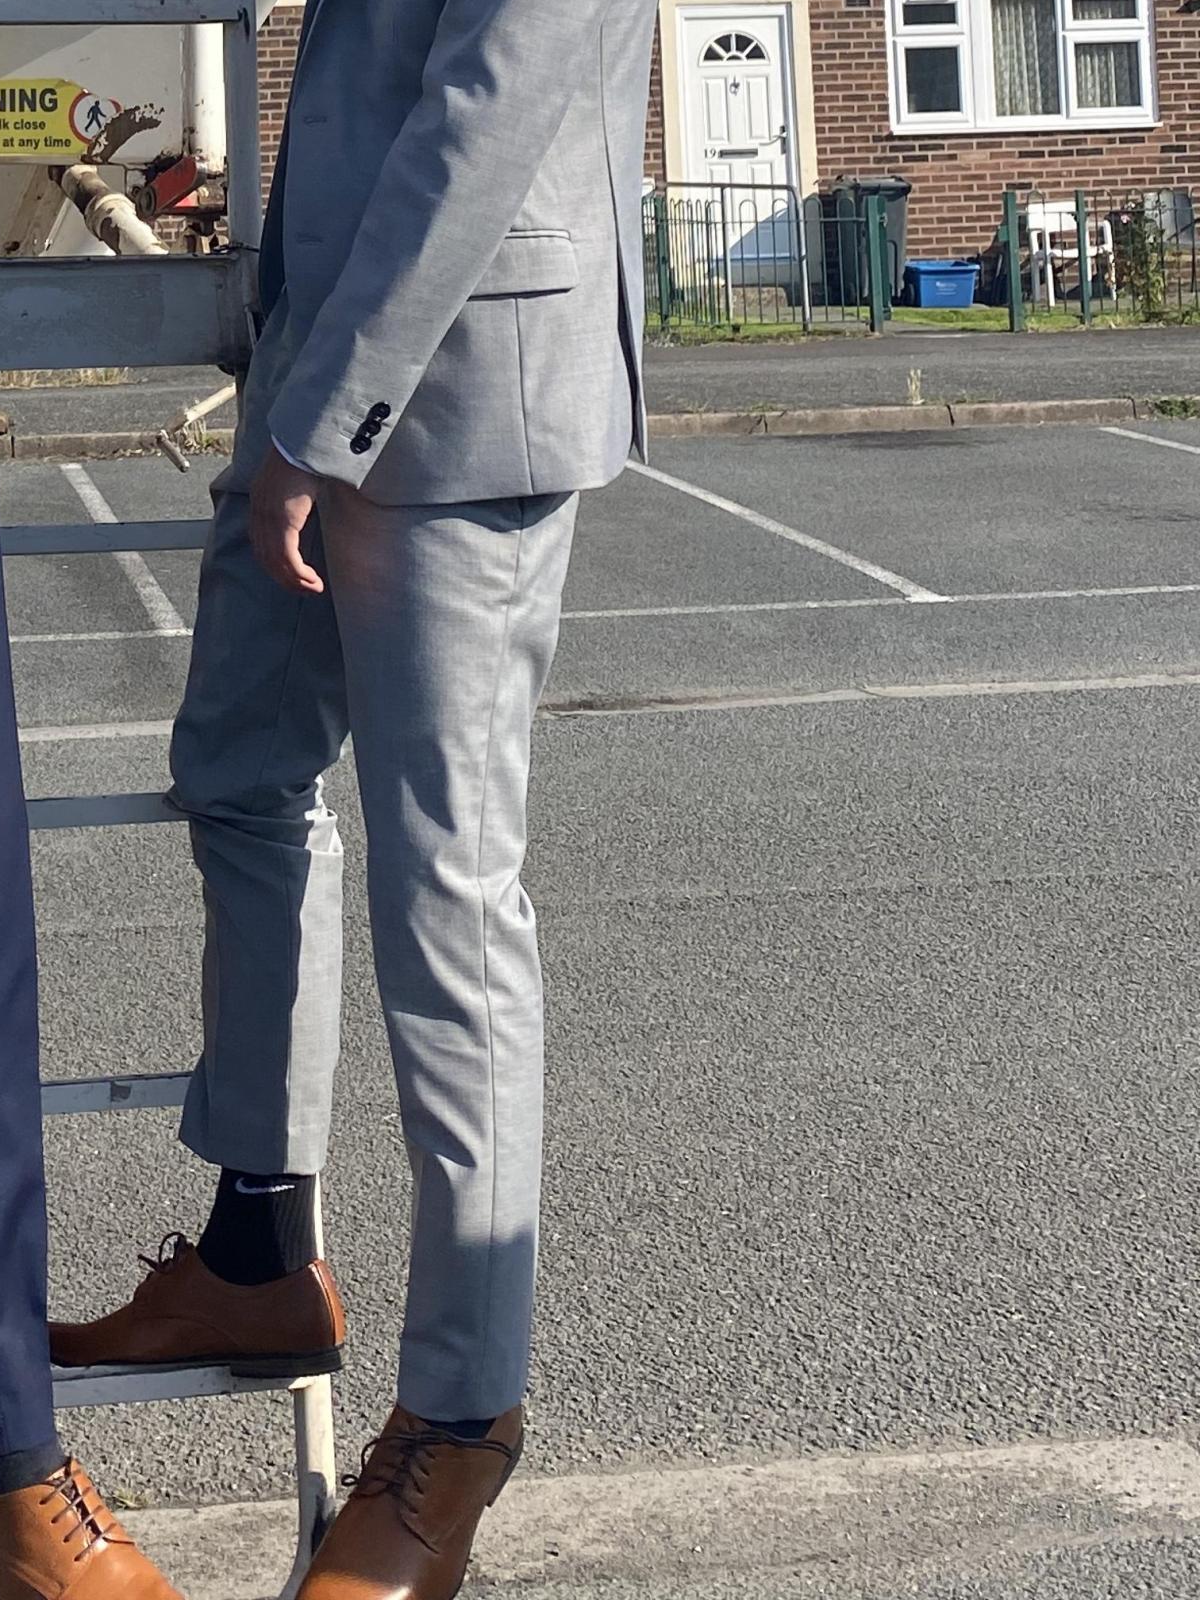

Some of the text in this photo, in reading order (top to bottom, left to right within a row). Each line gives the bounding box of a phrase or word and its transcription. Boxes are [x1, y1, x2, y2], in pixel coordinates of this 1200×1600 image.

[13, 118, 47, 131] close
[2, 136, 16, 148] at
[19, 138, 41, 150] any
[44, 136, 72, 148] time
[704, 148, 717, 159] 19
